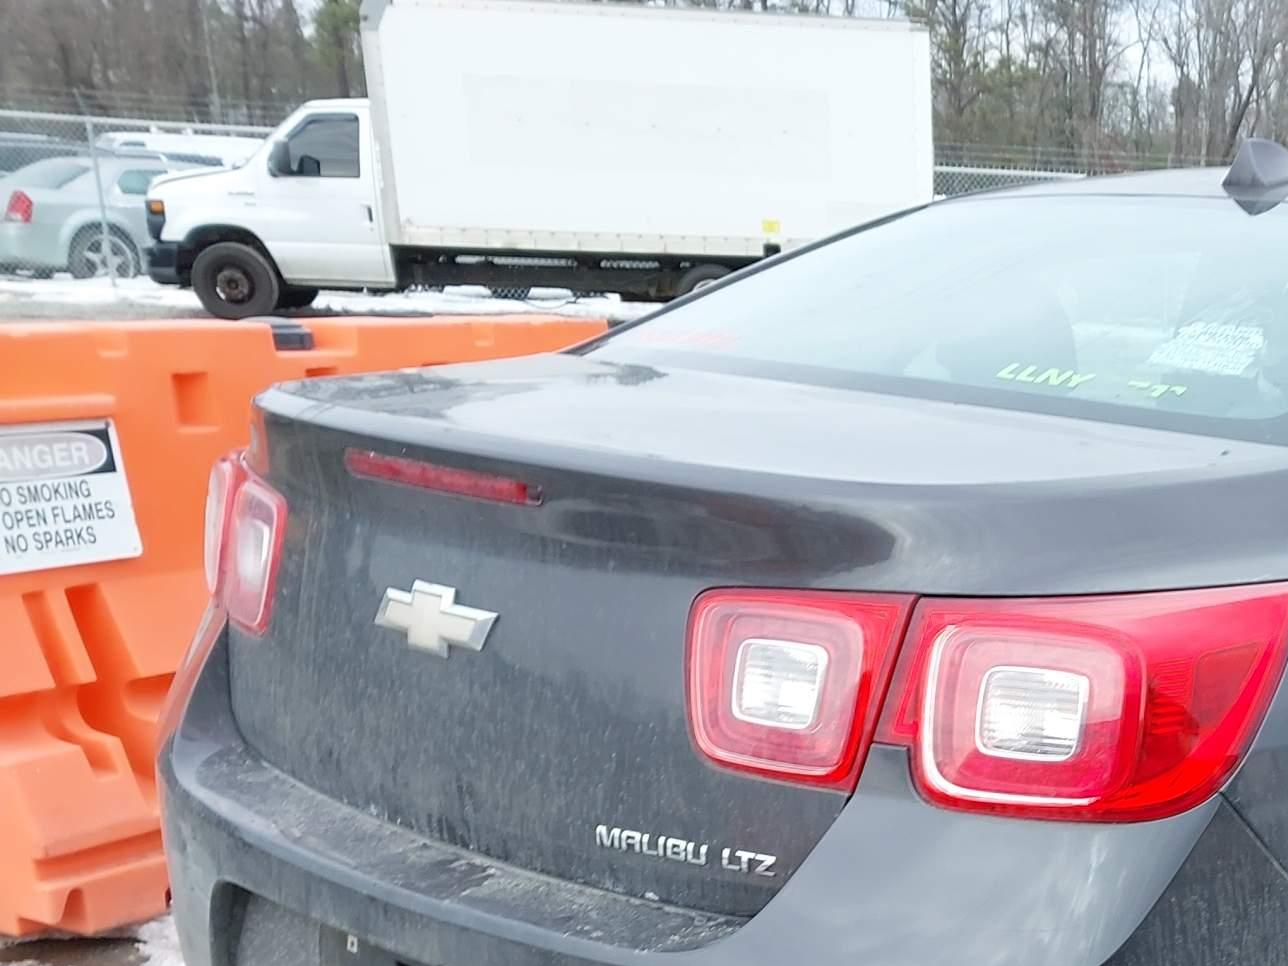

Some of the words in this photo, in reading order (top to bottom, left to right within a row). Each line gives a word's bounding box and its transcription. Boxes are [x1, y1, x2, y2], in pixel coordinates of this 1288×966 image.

[15, 479, 92, 505] SMOKING
[2, 508, 48, 530] OPEN
[51, 500, 116, 524] FLAMES
[4, 533, 29, 554] NO
[33, 526, 97, 551] SPARKS
[595, 824, 709, 866] MALIBU
[721, 847, 777, 877] LTZ
